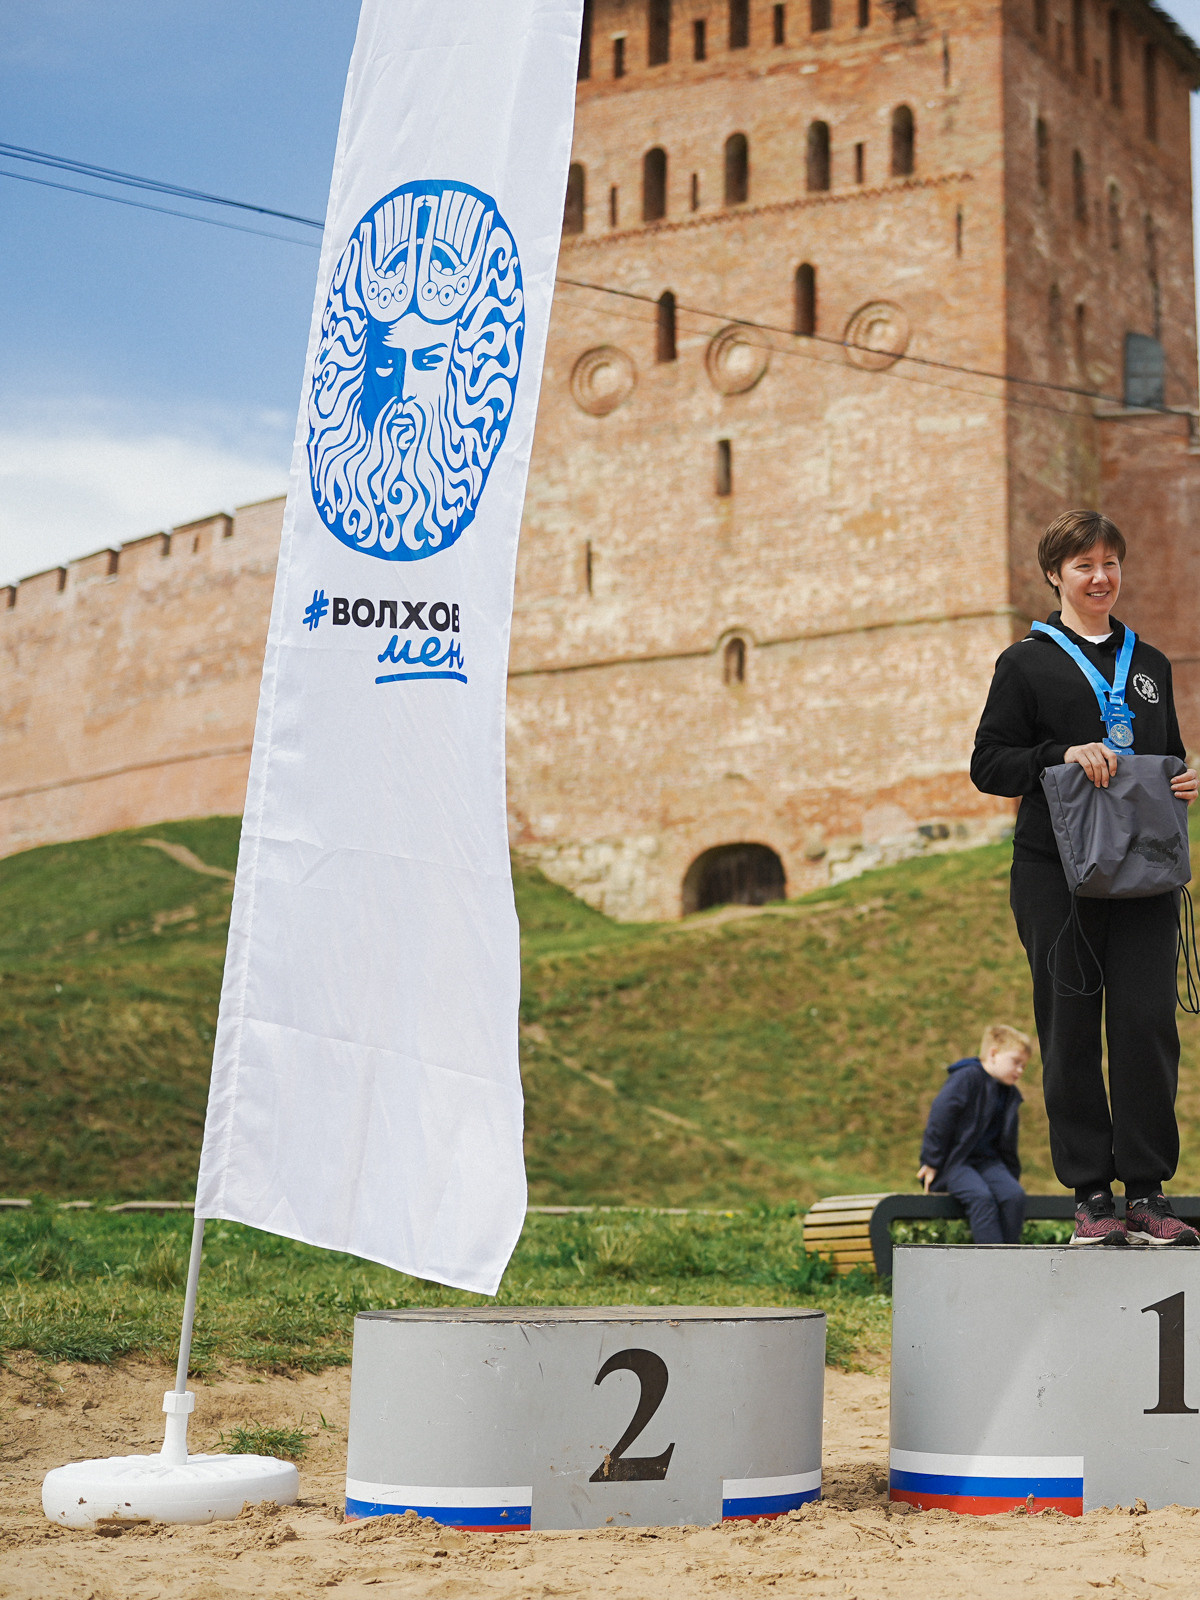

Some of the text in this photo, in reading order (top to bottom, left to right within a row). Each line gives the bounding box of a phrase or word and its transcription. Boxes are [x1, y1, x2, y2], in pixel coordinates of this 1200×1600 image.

[303, 589, 460, 633] #ВОЛХОВ
[1141, 1291, 1199, 1414] 1
[589, 1348, 676, 1482] 2
